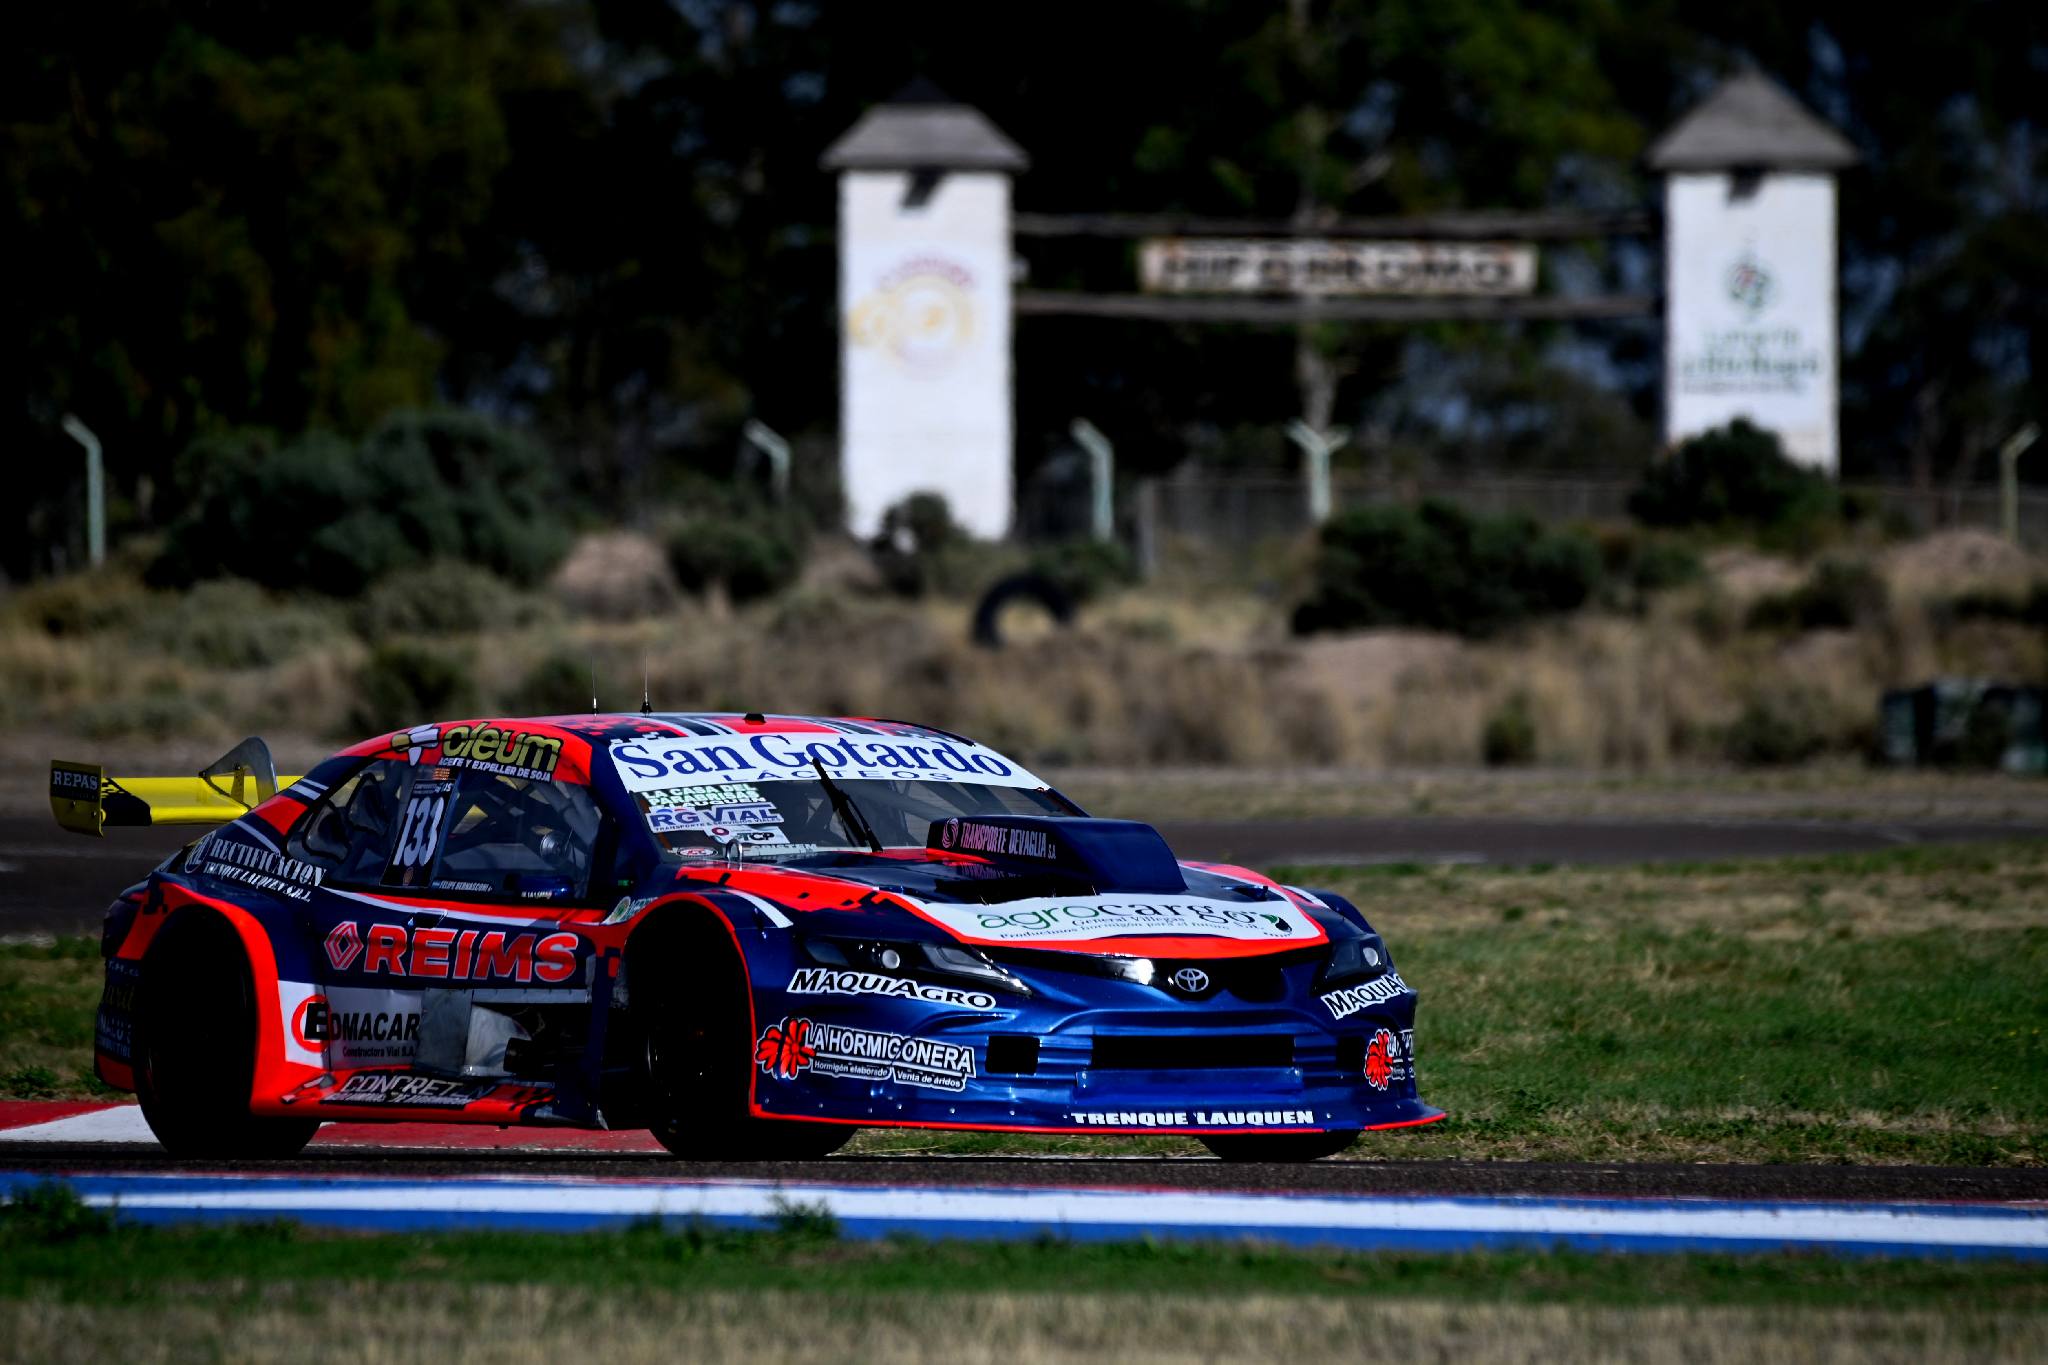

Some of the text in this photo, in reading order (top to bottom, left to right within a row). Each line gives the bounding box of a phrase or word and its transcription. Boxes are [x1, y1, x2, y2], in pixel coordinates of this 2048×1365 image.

[465, 759, 472, 767] Y
[472, 761, 516, 775] EXPELLER
[517, 768, 529, 777] DE
[530, 770, 551, 782] SOJA
[613, 735, 1012, 778] San Gotardo
[53, 770, 98, 790] REPAS
[642, 783, 757, 800] LA CASA DEL
[648, 790, 760, 806] PARABRISAS
[392, 796, 445, 867] 133
[960, 822, 1007, 853] TRANSPORTE
[1009, 829, 1047, 857] DEVAGLIA
[209, 838, 326, 886] RECTIFICACION
[363, 923, 580, 983] REIMS
[1322, 972, 1408, 1018] MAQUIA
[342, 1045, 385, 1058] Constructora
[386, 1046, 400, 1057] Vial
[805, 1027, 973, 1074] LA HORMIGONERA
[814, 1060, 961, 1088] Hormigón elaborado Venta de áridos
[1071, 1111, 1314, 1125] TRENQUE LAUQUEN
